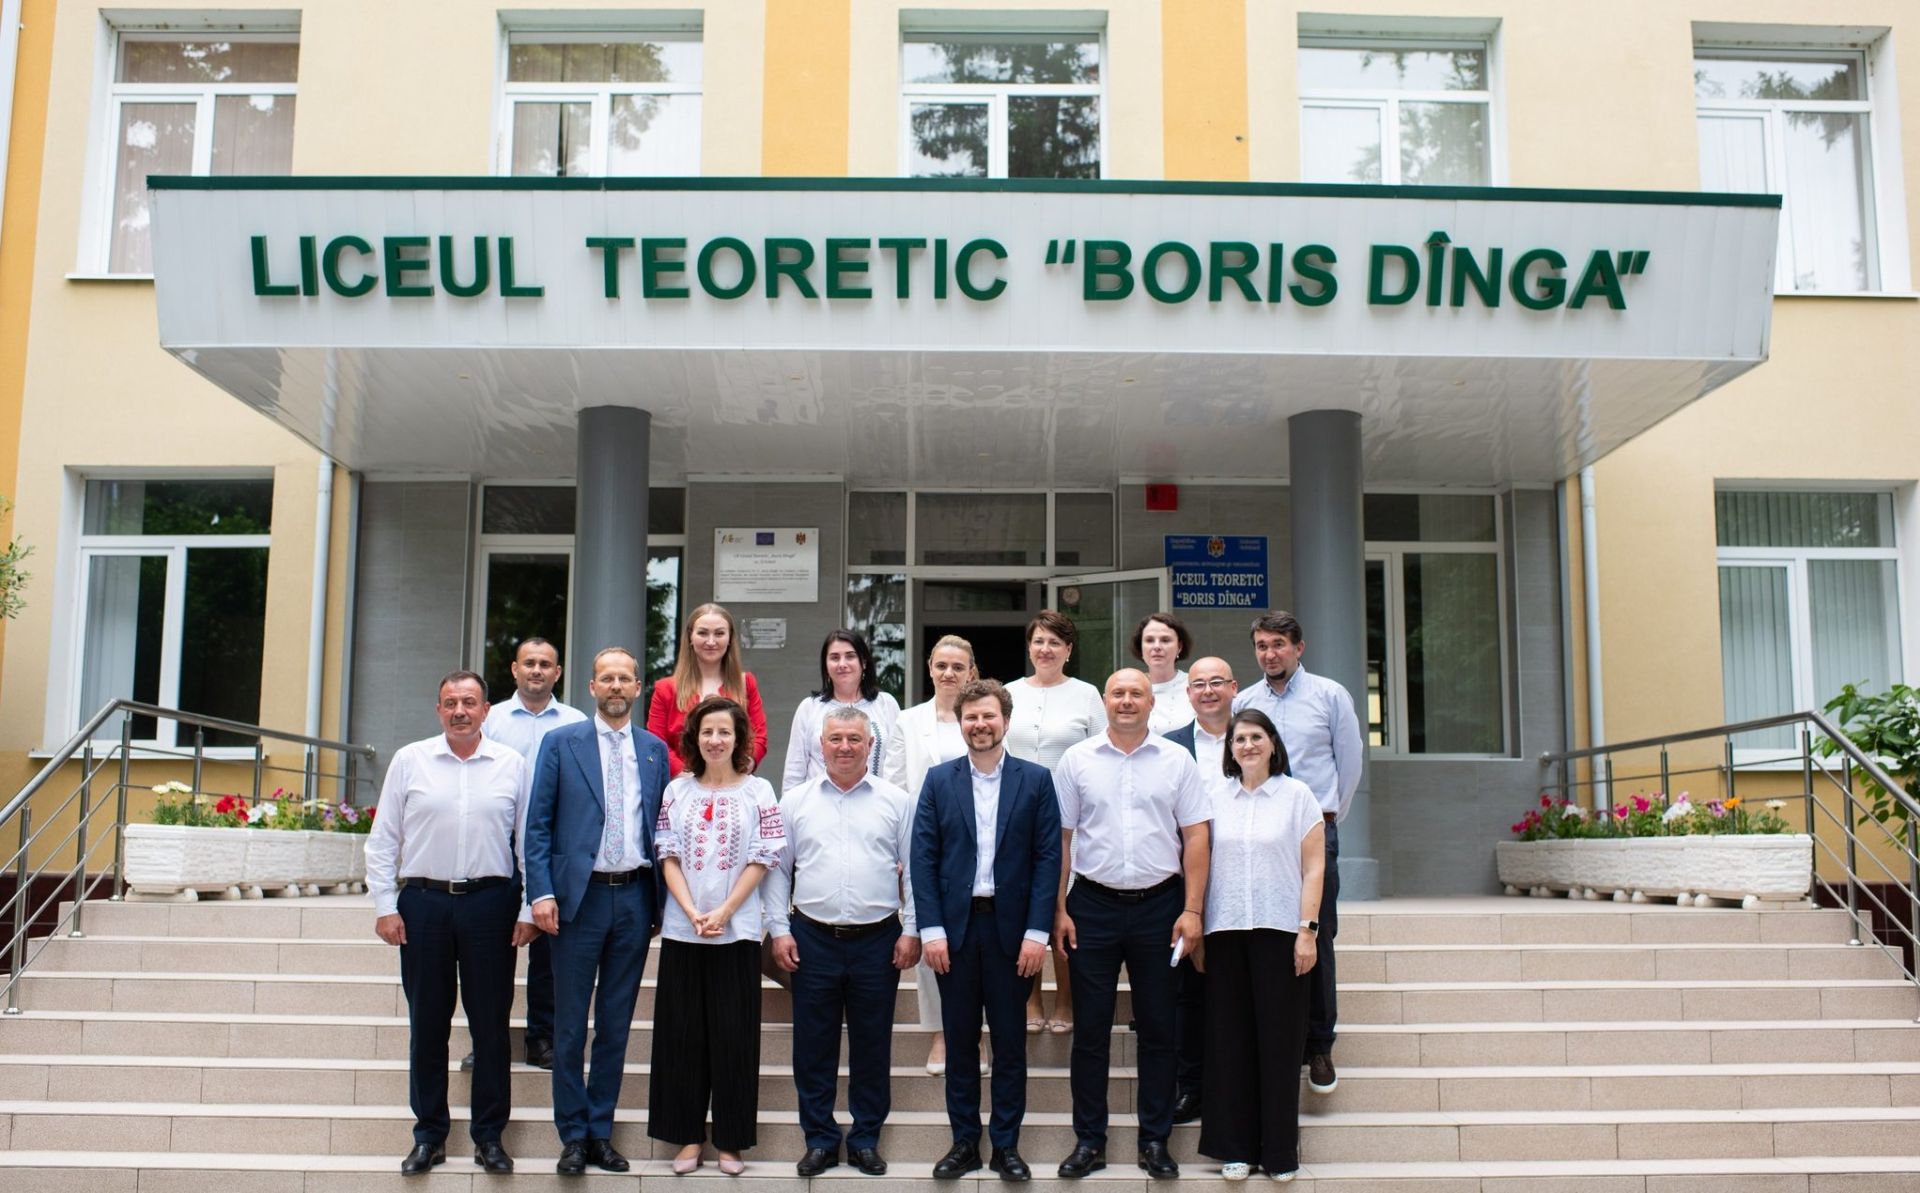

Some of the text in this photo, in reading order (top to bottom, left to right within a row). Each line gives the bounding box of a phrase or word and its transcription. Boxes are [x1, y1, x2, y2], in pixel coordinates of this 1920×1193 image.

[250, 235, 545, 299] LICEUL
[586, 236, 1009, 302] TEORETIC
[1044, 238, 1340, 308] "BORIS
[1210, 573, 1264, 586] TEORETIC
